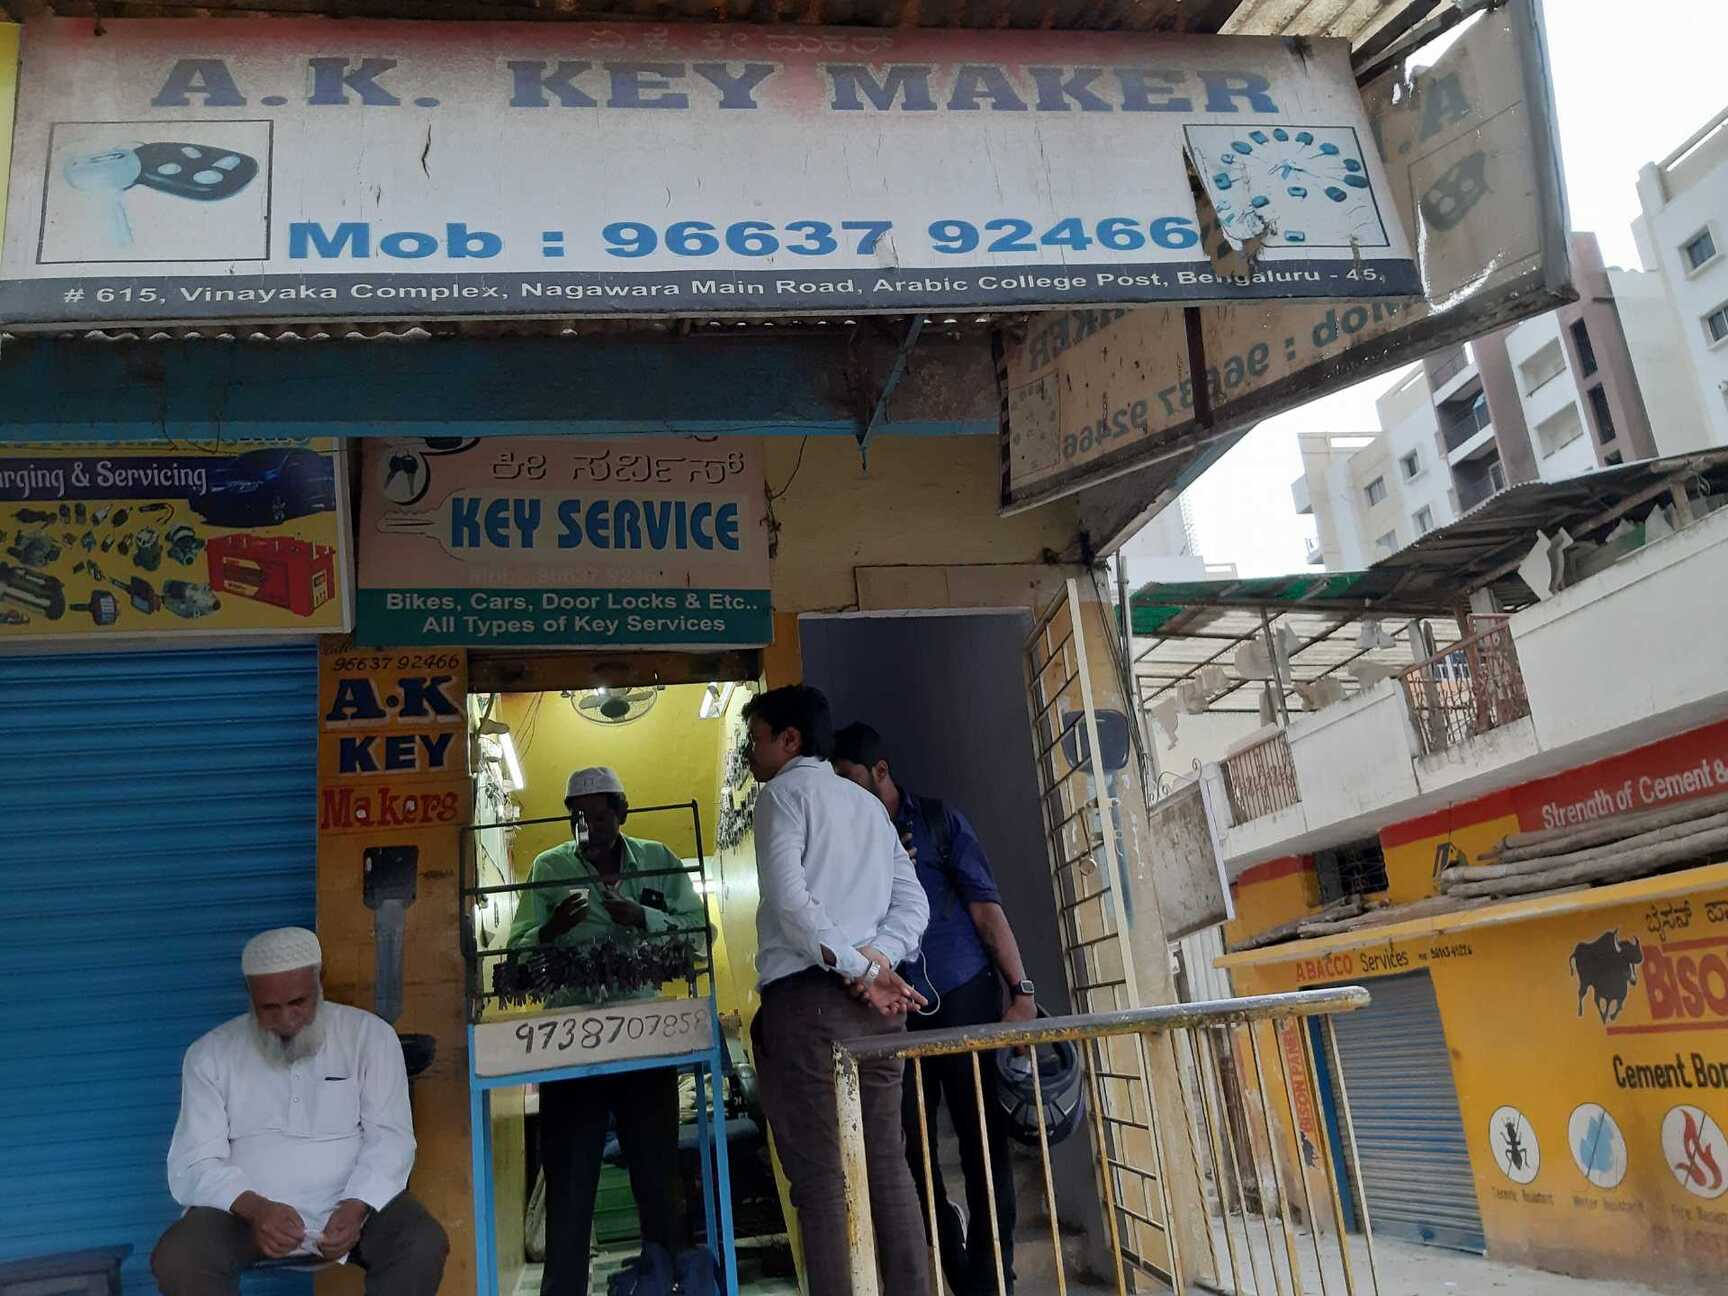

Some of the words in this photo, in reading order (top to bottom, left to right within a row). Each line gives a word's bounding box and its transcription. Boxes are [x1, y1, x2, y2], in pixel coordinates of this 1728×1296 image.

[507, 60, 776, 111] KEY
[826, 62, 1280, 114] MAKER
[288, 221, 502, 259] Mob
[601, 219, 893, 257] 96637
[928, 216, 1198, 255] 92466
[96, 286, 165, 306] 615,
[181, 283, 337, 304] Vinayaka
[350, 281, 507, 302] Complex,
[521, 279, 679, 299] Nagawara
[692, 278, 765, 295] Main
[776, 277, 863, 297] Road,
[873, 275, 968, 294] Arabic
[978, 273, 1088, 294] College
[1096, 271, 1168, 291] Post,
[72, 461, 91, 488] &
[97, 460, 208, 495] Servicing
[452, 497, 541, 550] KEY
[558, 498, 740, 551] SERVICE
[386, 592, 462, 612] Bikes,
[470, 593, 533, 612] Cars,
[543, 593, 600, 611] Door
[607, 593, 677, 611] Locks
[685, 593, 702, 611] &
[422, 616, 456, 633] All
[464, 616, 535, 637] Types
[543, 616, 568, 633] of
[575, 616, 619, 636] Key
[627, 616, 726, 633] Services
[338, 732, 455, 774] KEY
[1616, 779, 1634, 811] of
[1638, 758, 1714, 804] Cement
[320, 784, 460, 829] Makers
[1295, 953, 1353, 983] ABACCO
[1359, 948, 1410, 973] Services
[1612, 1053, 1693, 1089] Cement
